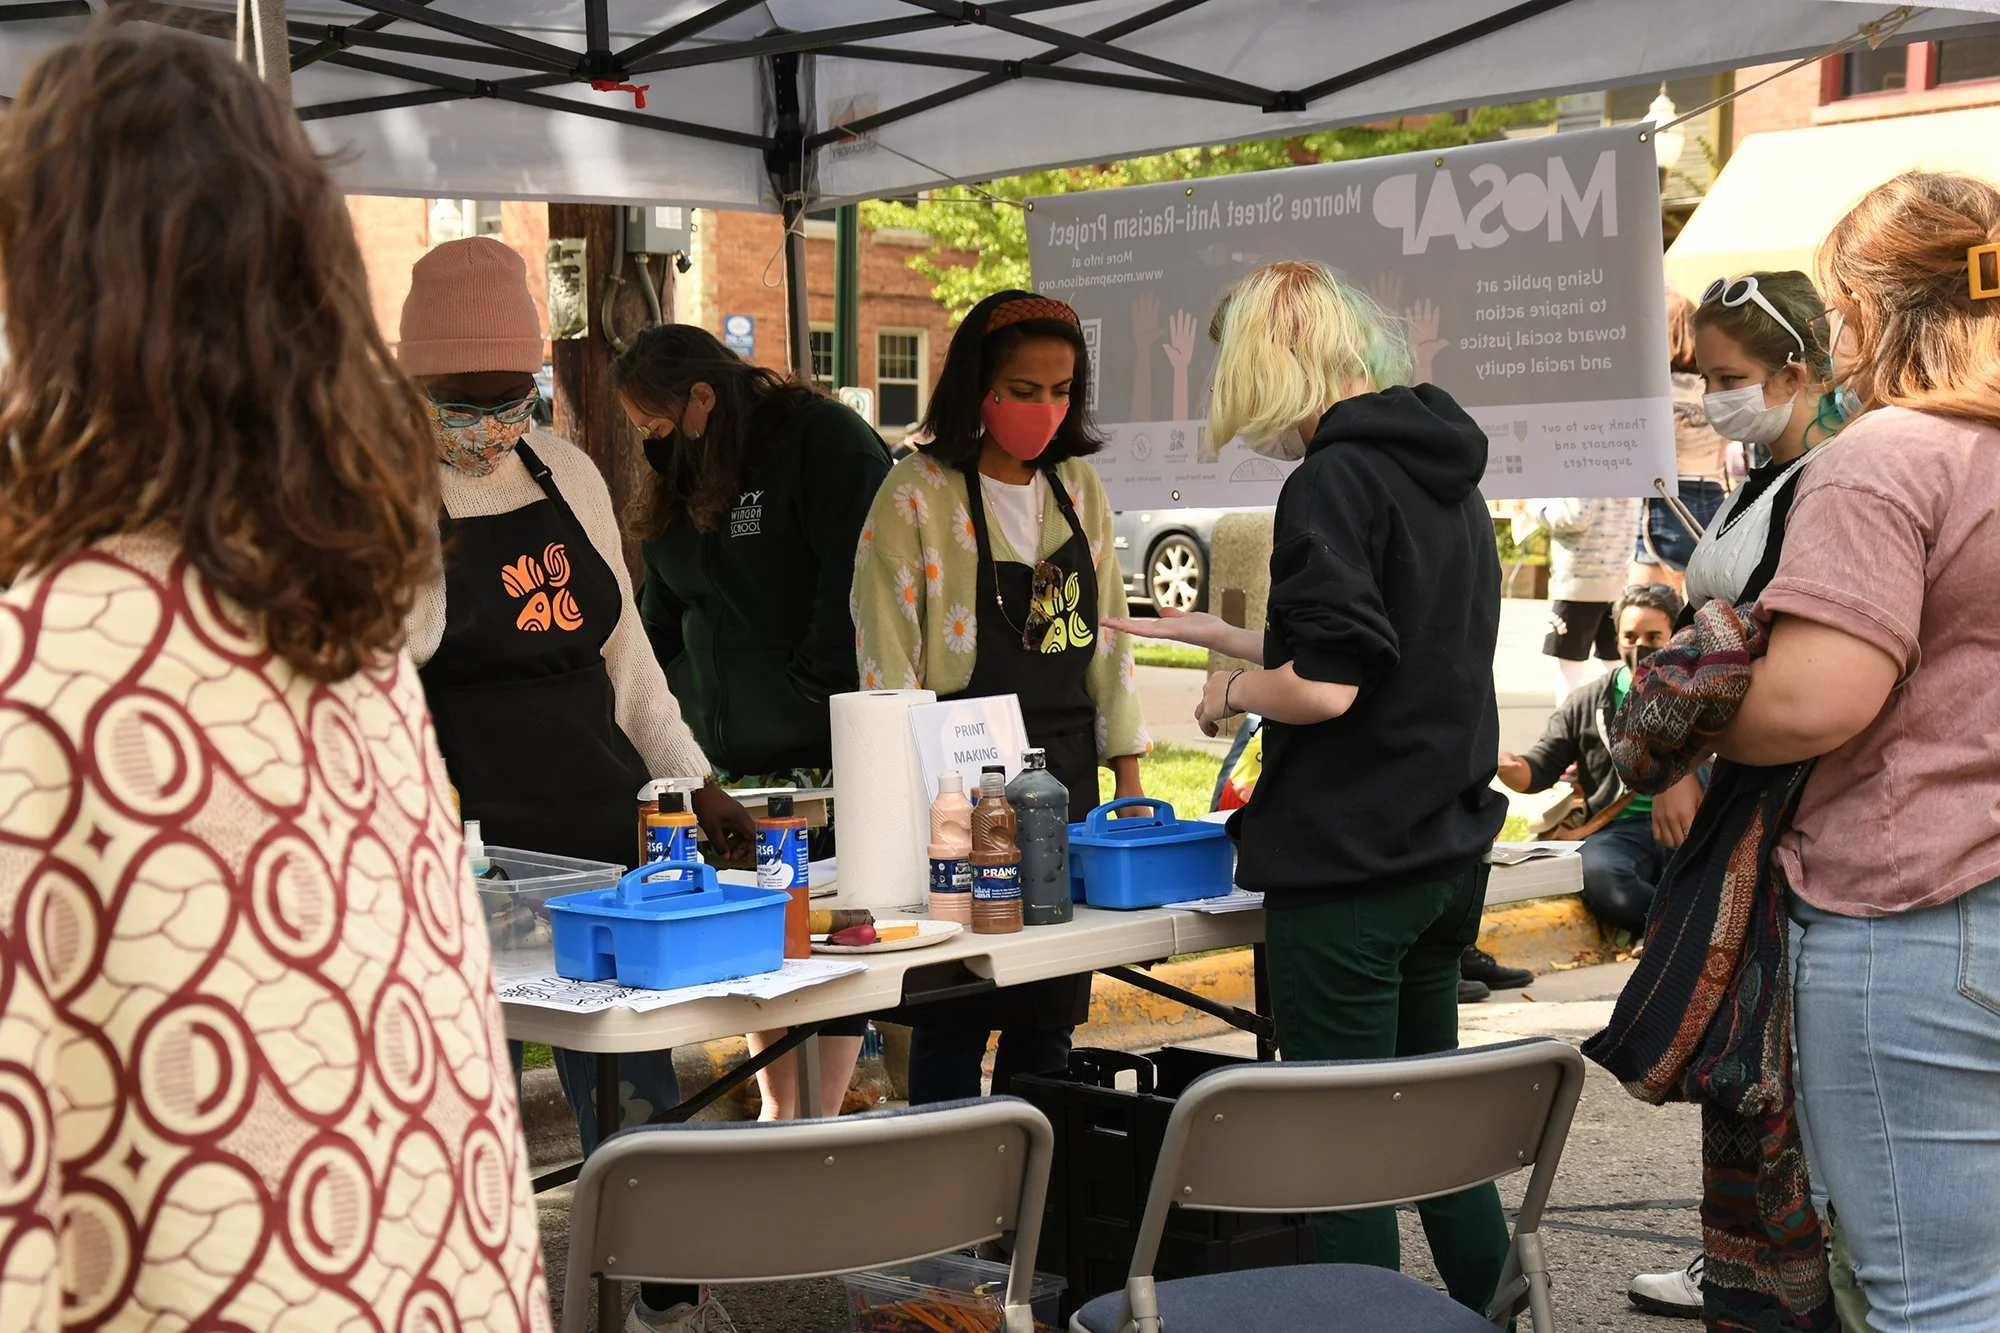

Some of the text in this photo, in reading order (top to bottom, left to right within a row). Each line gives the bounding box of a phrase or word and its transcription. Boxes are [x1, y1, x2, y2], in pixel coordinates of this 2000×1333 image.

[731, 508, 762, 521] WINGRA
[730, 522, 761, 535] SCHOOL
[954, 722, 986, 738] PRINT
[953, 746, 999, 764] MAKING
[983, 866, 1017, 878] PRANG
